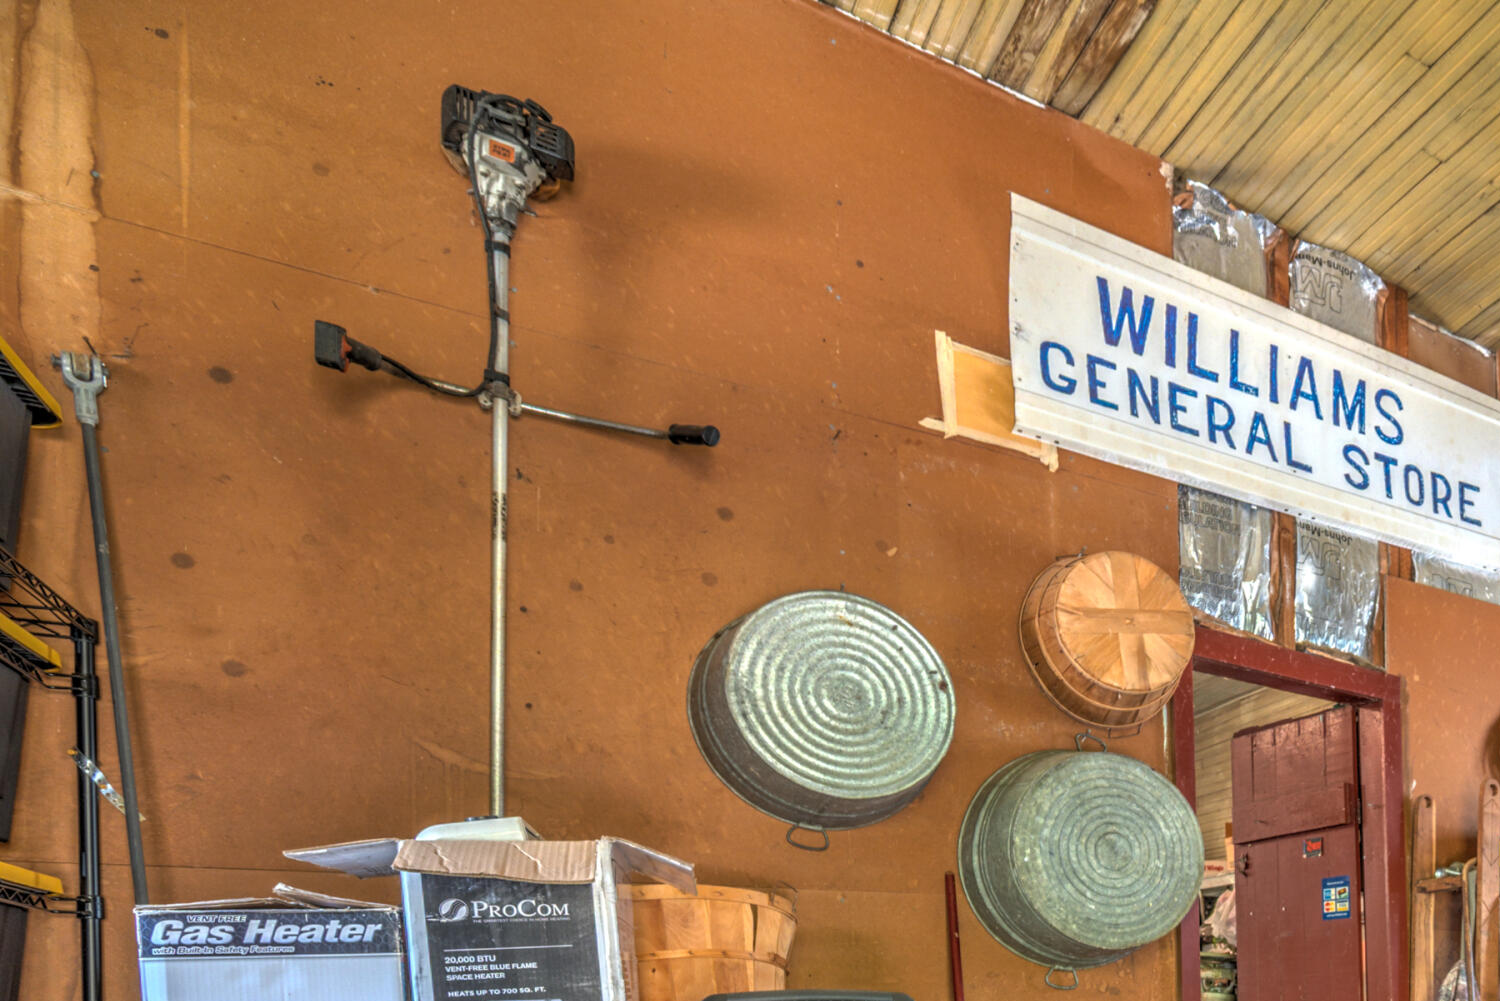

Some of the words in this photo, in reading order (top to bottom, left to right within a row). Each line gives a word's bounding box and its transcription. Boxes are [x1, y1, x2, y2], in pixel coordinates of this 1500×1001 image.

[1097, 276, 1404, 445] WILLIAMS
[1039, 341, 1313, 474] GENERAL
[1343, 444, 1482, 528] STORE
[218, 914, 247, 922] FREE
[149, 920, 235, 945] Gas
[241, 919, 382, 944] Heater
[215, 945, 249, 954] Safety
[250, 945, 294, 953] Features
[444, 955, 474, 964] 20,000
[477, 954, 496, 962] BTU
[445, 964, 487, 972] VENT-FREE
